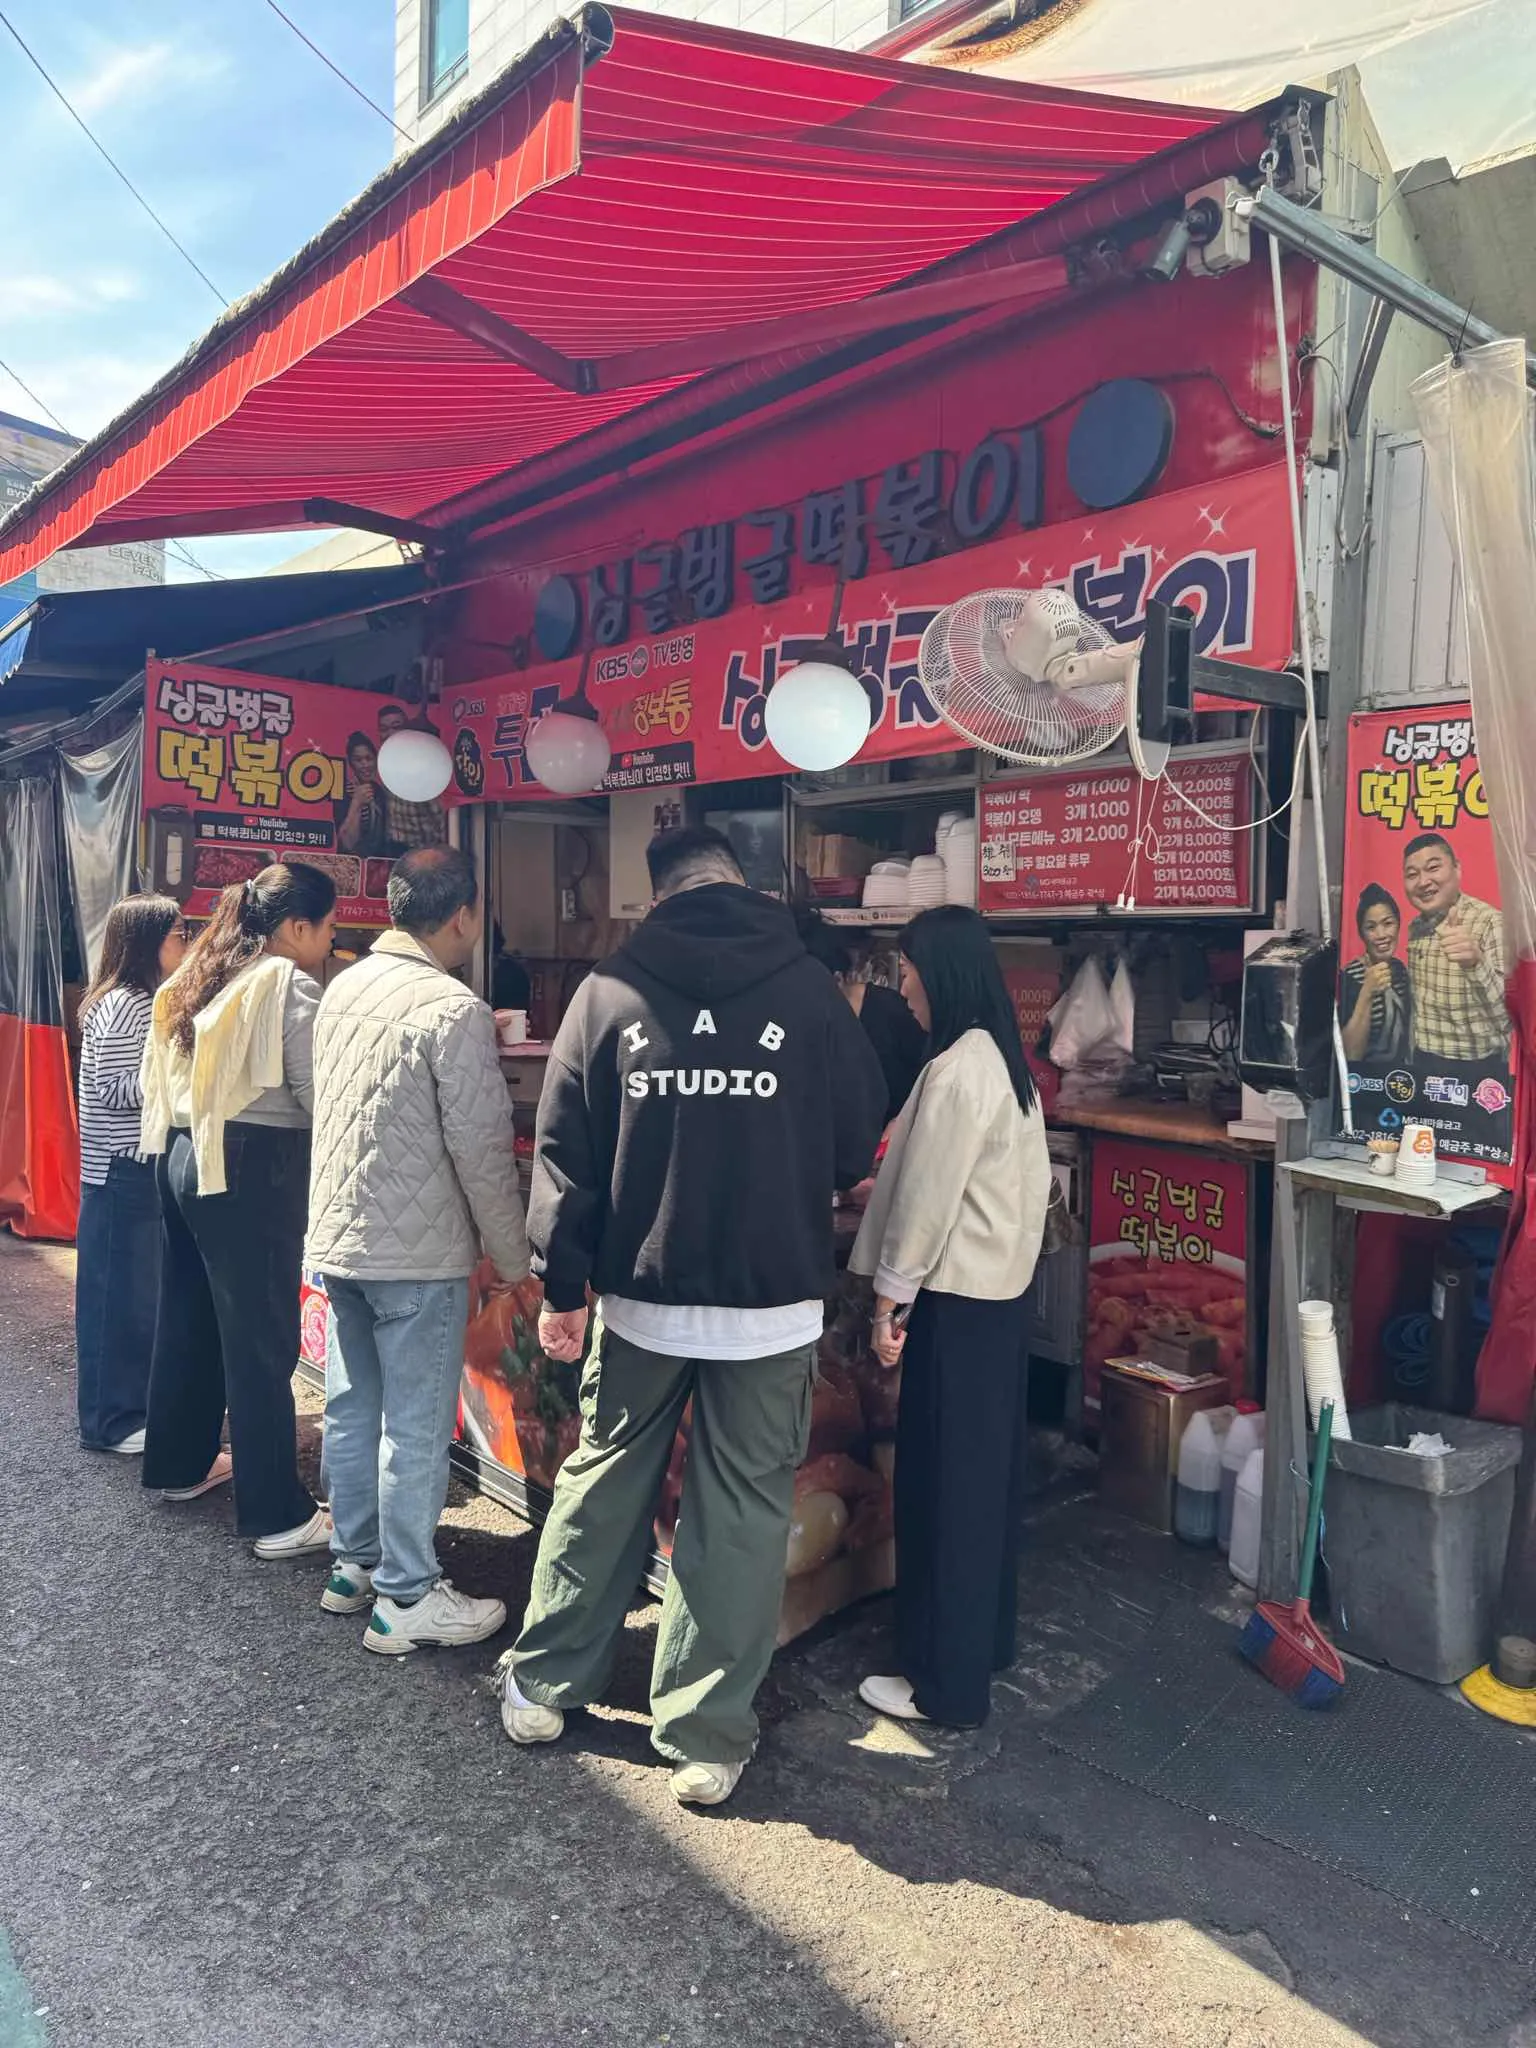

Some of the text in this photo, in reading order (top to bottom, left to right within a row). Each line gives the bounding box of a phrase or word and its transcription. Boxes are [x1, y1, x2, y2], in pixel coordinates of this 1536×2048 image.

[596, 635, 694, 683] KBS TV방영
[157, 679, 293, 737] 싱글벙글
[1384, 718, 1481, 763] 싱글벙
[158, 731, 344, 806] 떡볶이
[1065, 782, 1088, 798] 3개
[259, 818, 288, 829] YouTube
[1018, 808, 1042, 825] 오뎅
[1065, 803, 1087, 820] 3개
[1060, 828, 1082, 844] 3개
[627, 1069, 778, 1098] STUDIO
[1361, 1078, 1383, 1090] SBS
[1439, 1138, 1472, 1153] 예금주
[1111, 1168, 1225, 1230] 싱글벙글
[1120, 1215, 1213, 1264] 떡볶이
